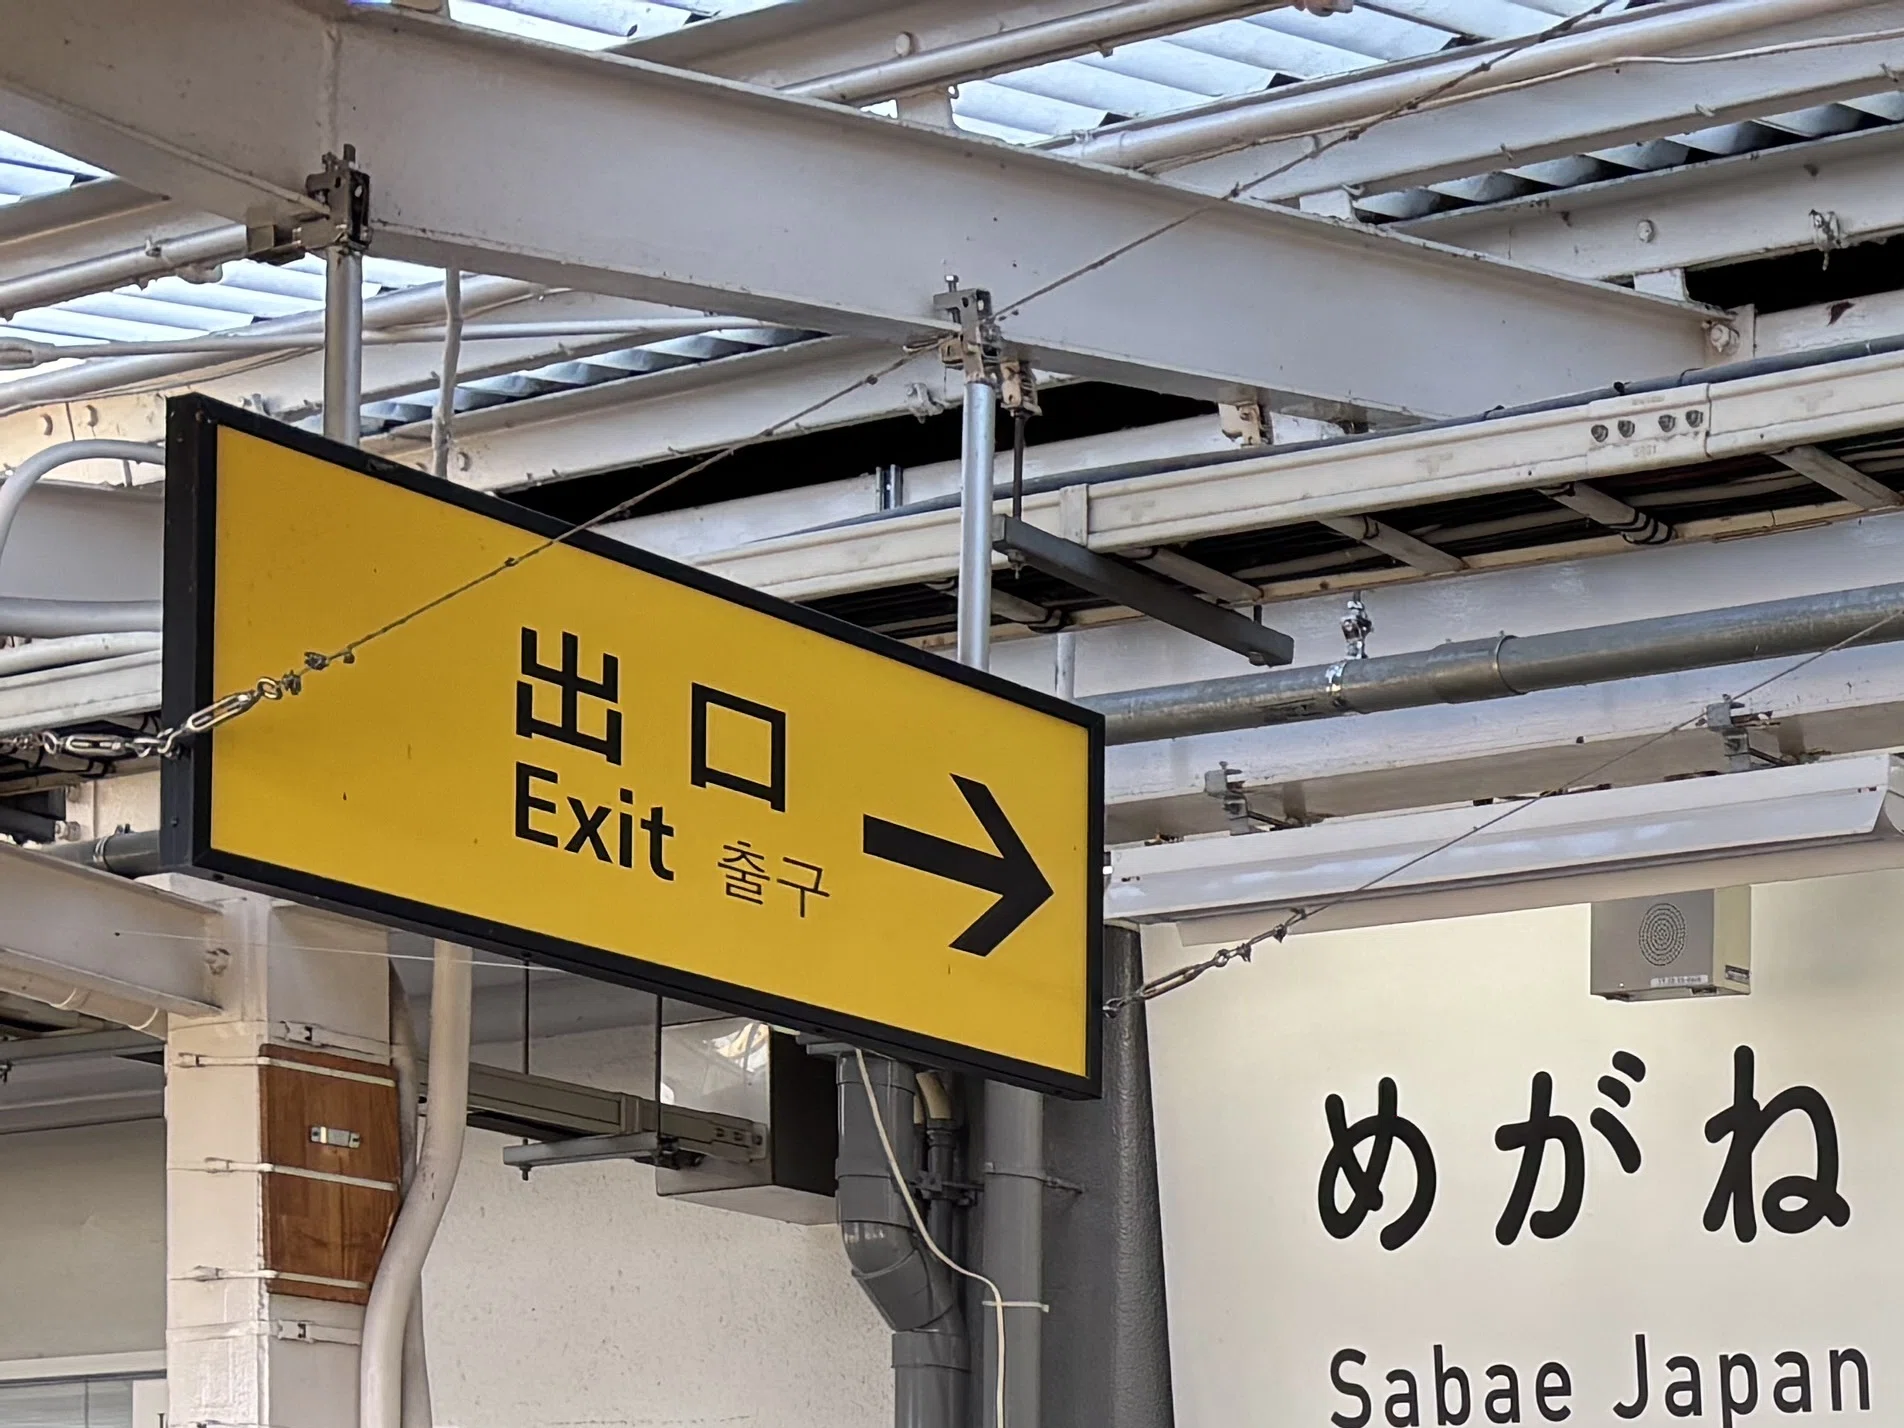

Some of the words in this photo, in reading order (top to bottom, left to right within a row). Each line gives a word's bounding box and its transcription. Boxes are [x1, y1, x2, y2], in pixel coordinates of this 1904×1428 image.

[515, 627, 788, 814] 出口
[514, 760, 675, 883] Exit
[715, 839, 830, 919] 출구
